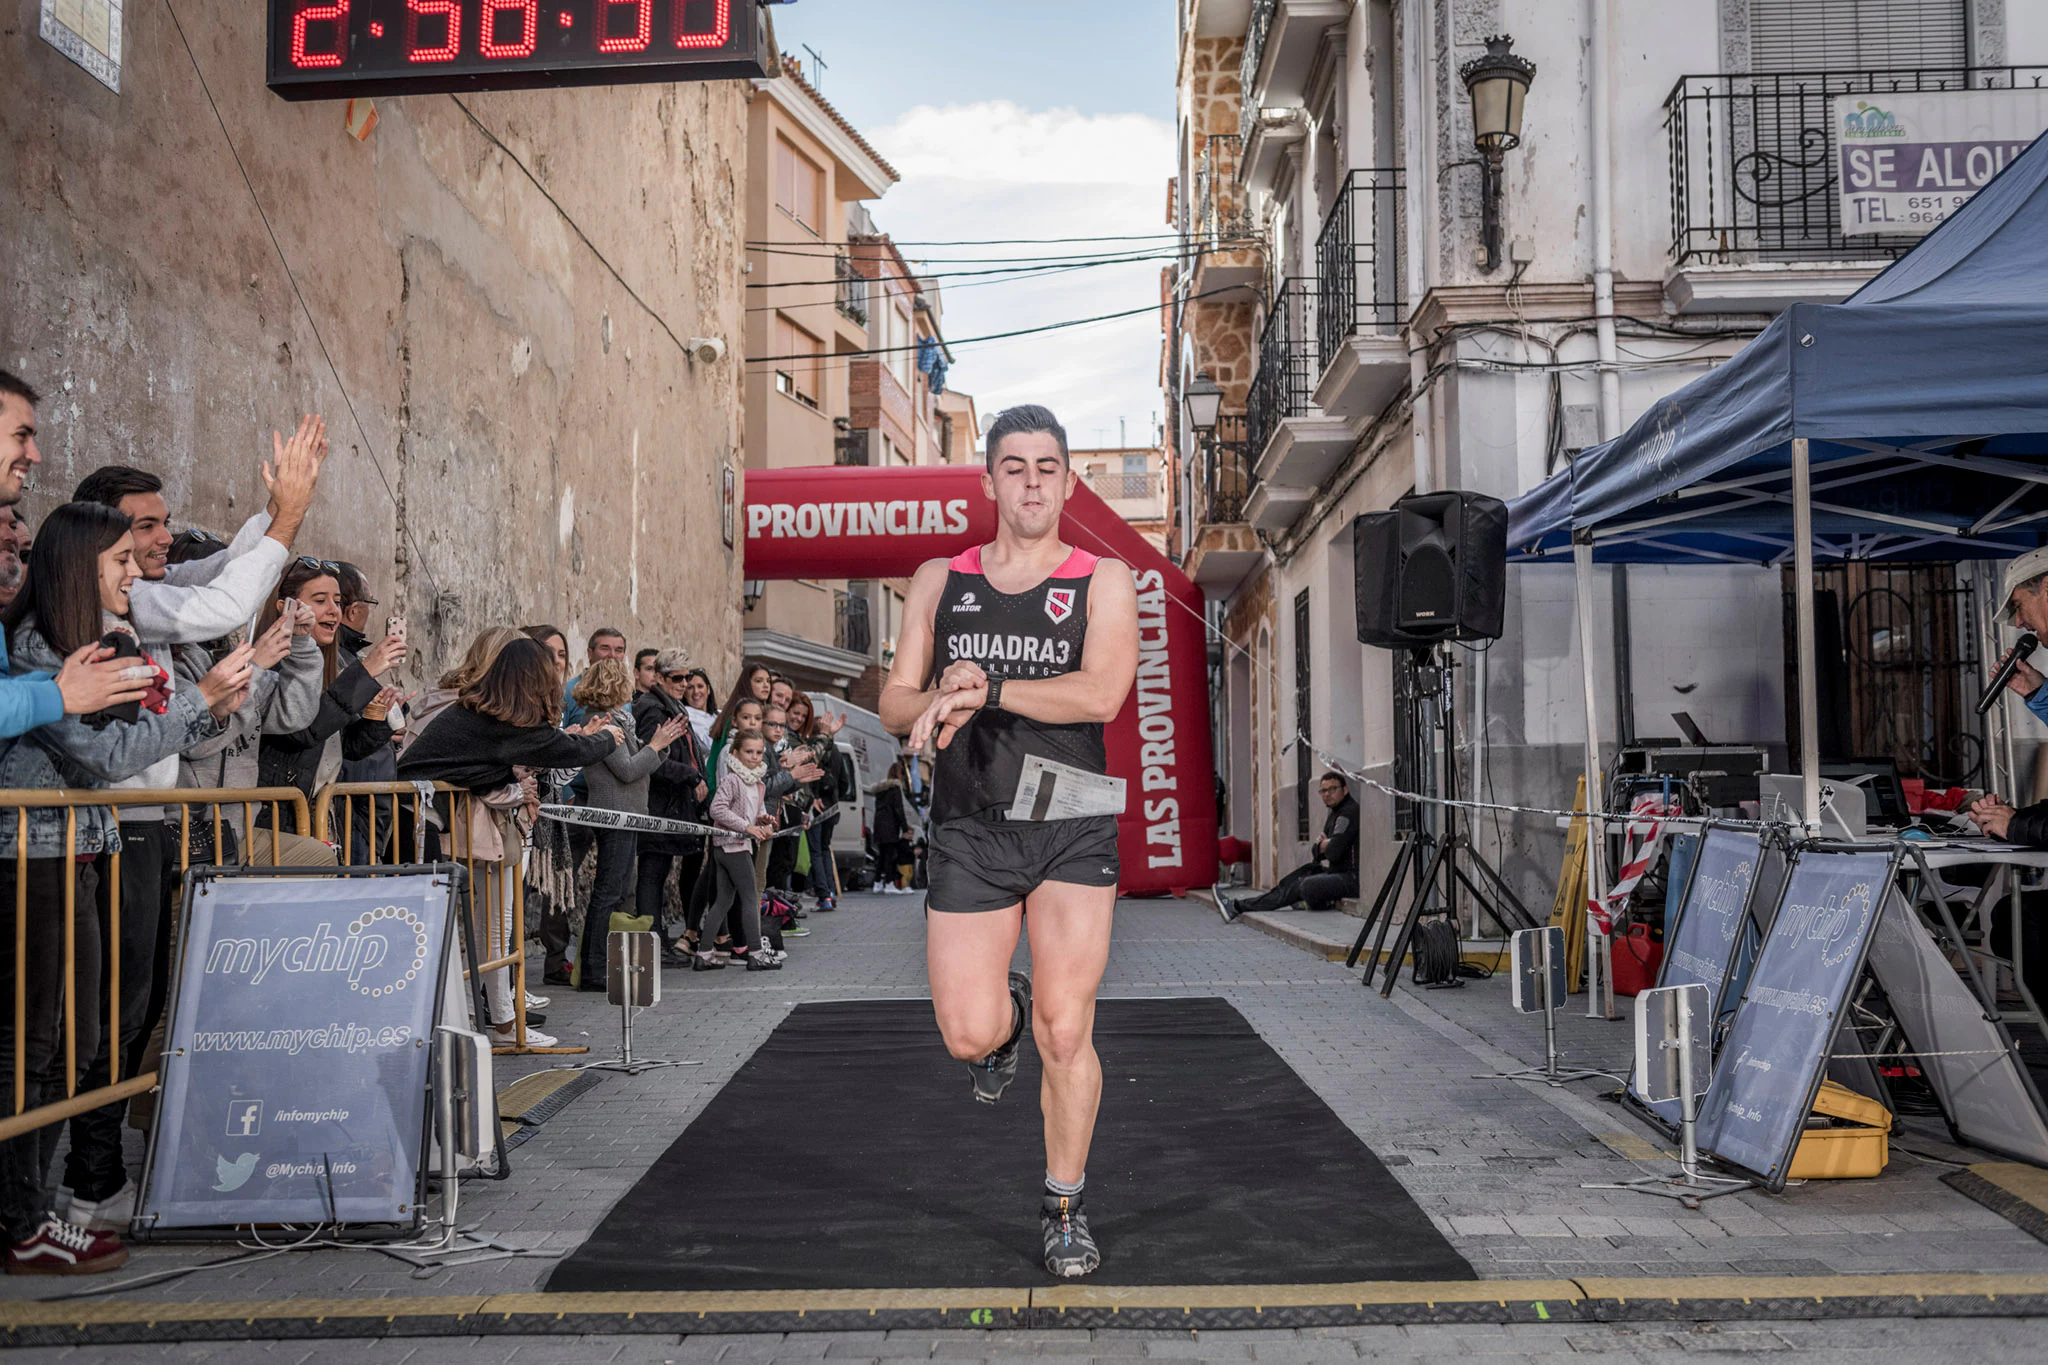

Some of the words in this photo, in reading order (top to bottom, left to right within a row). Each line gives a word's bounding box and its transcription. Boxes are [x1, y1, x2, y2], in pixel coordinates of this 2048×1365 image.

[1850, 149, 1897, 189] SE
[1908, 197, 1943, 209] 651
[1909, 212, 1945, 223] 964
[748, 500, 969, 538] PROVINCIAS
[952, 604, 982, 613] VIATOR
[947, 633, 1070, 665] SQUADRA3
[1136, 569, 1178, 792] PROVINCIAS
[1144, 797, 1182, 868] LAS
[1777, 895, 1850, 952] mychip
[205, 923, 388, 985] mychip
[193, 1022, 412, 1055] www.mychip.es
[274, 1108, 349, 1124] /infomychip
